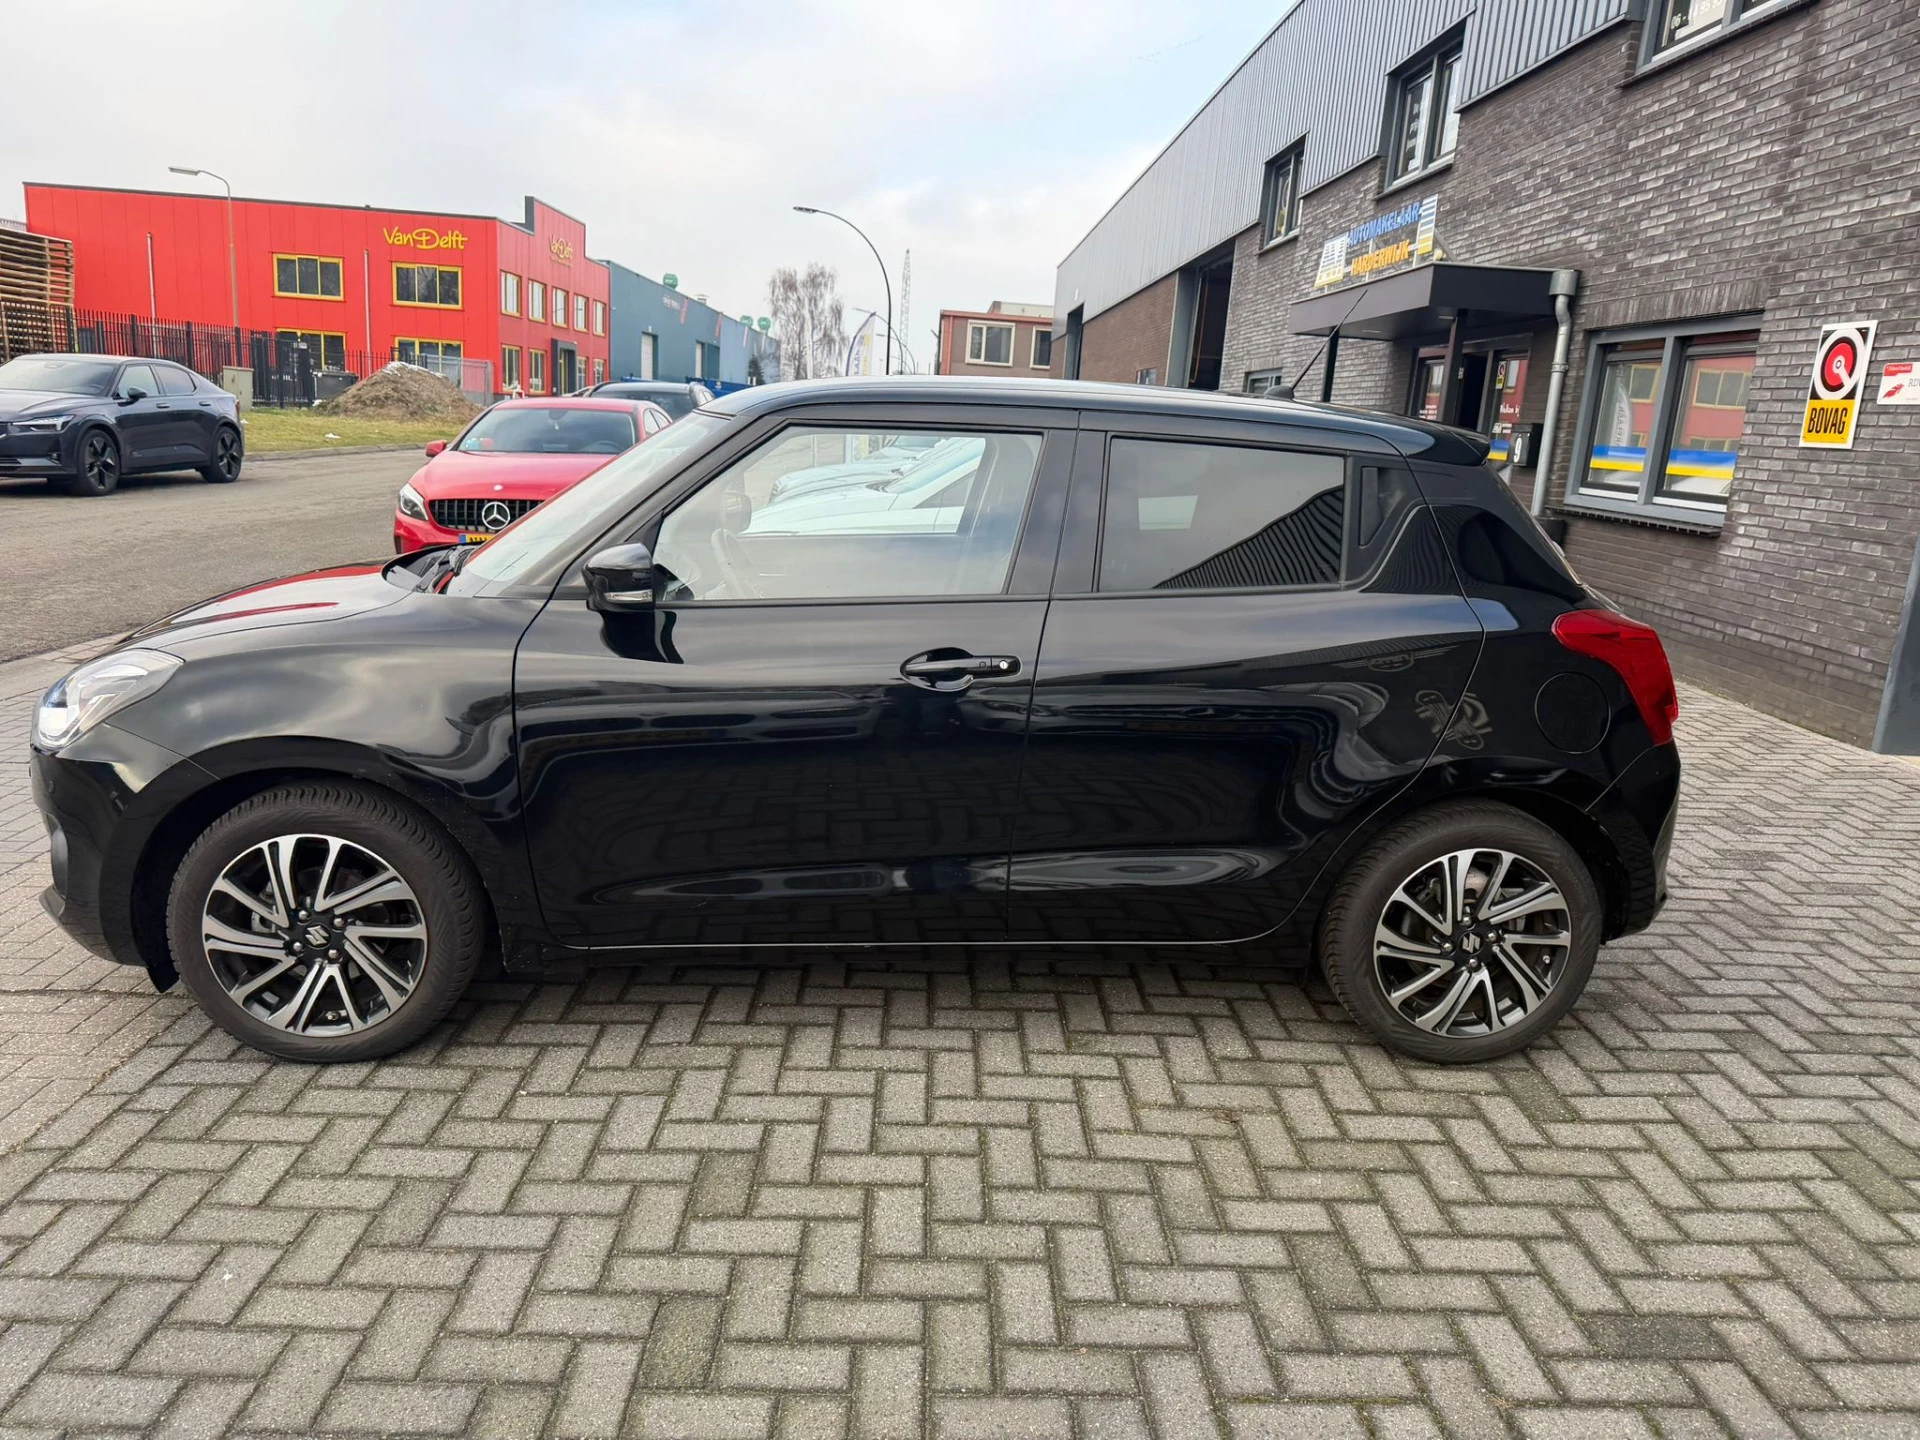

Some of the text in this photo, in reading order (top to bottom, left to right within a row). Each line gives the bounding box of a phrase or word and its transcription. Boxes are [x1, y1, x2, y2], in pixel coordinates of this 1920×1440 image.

[1348, 201, 1421, 247] AUTOMAKELAAR
[1350, 239, 1411, 276] HARDERWIJK
[1807, 407, 1848, 435] BOVAG
[1513, 436, 1523, 463] 9
